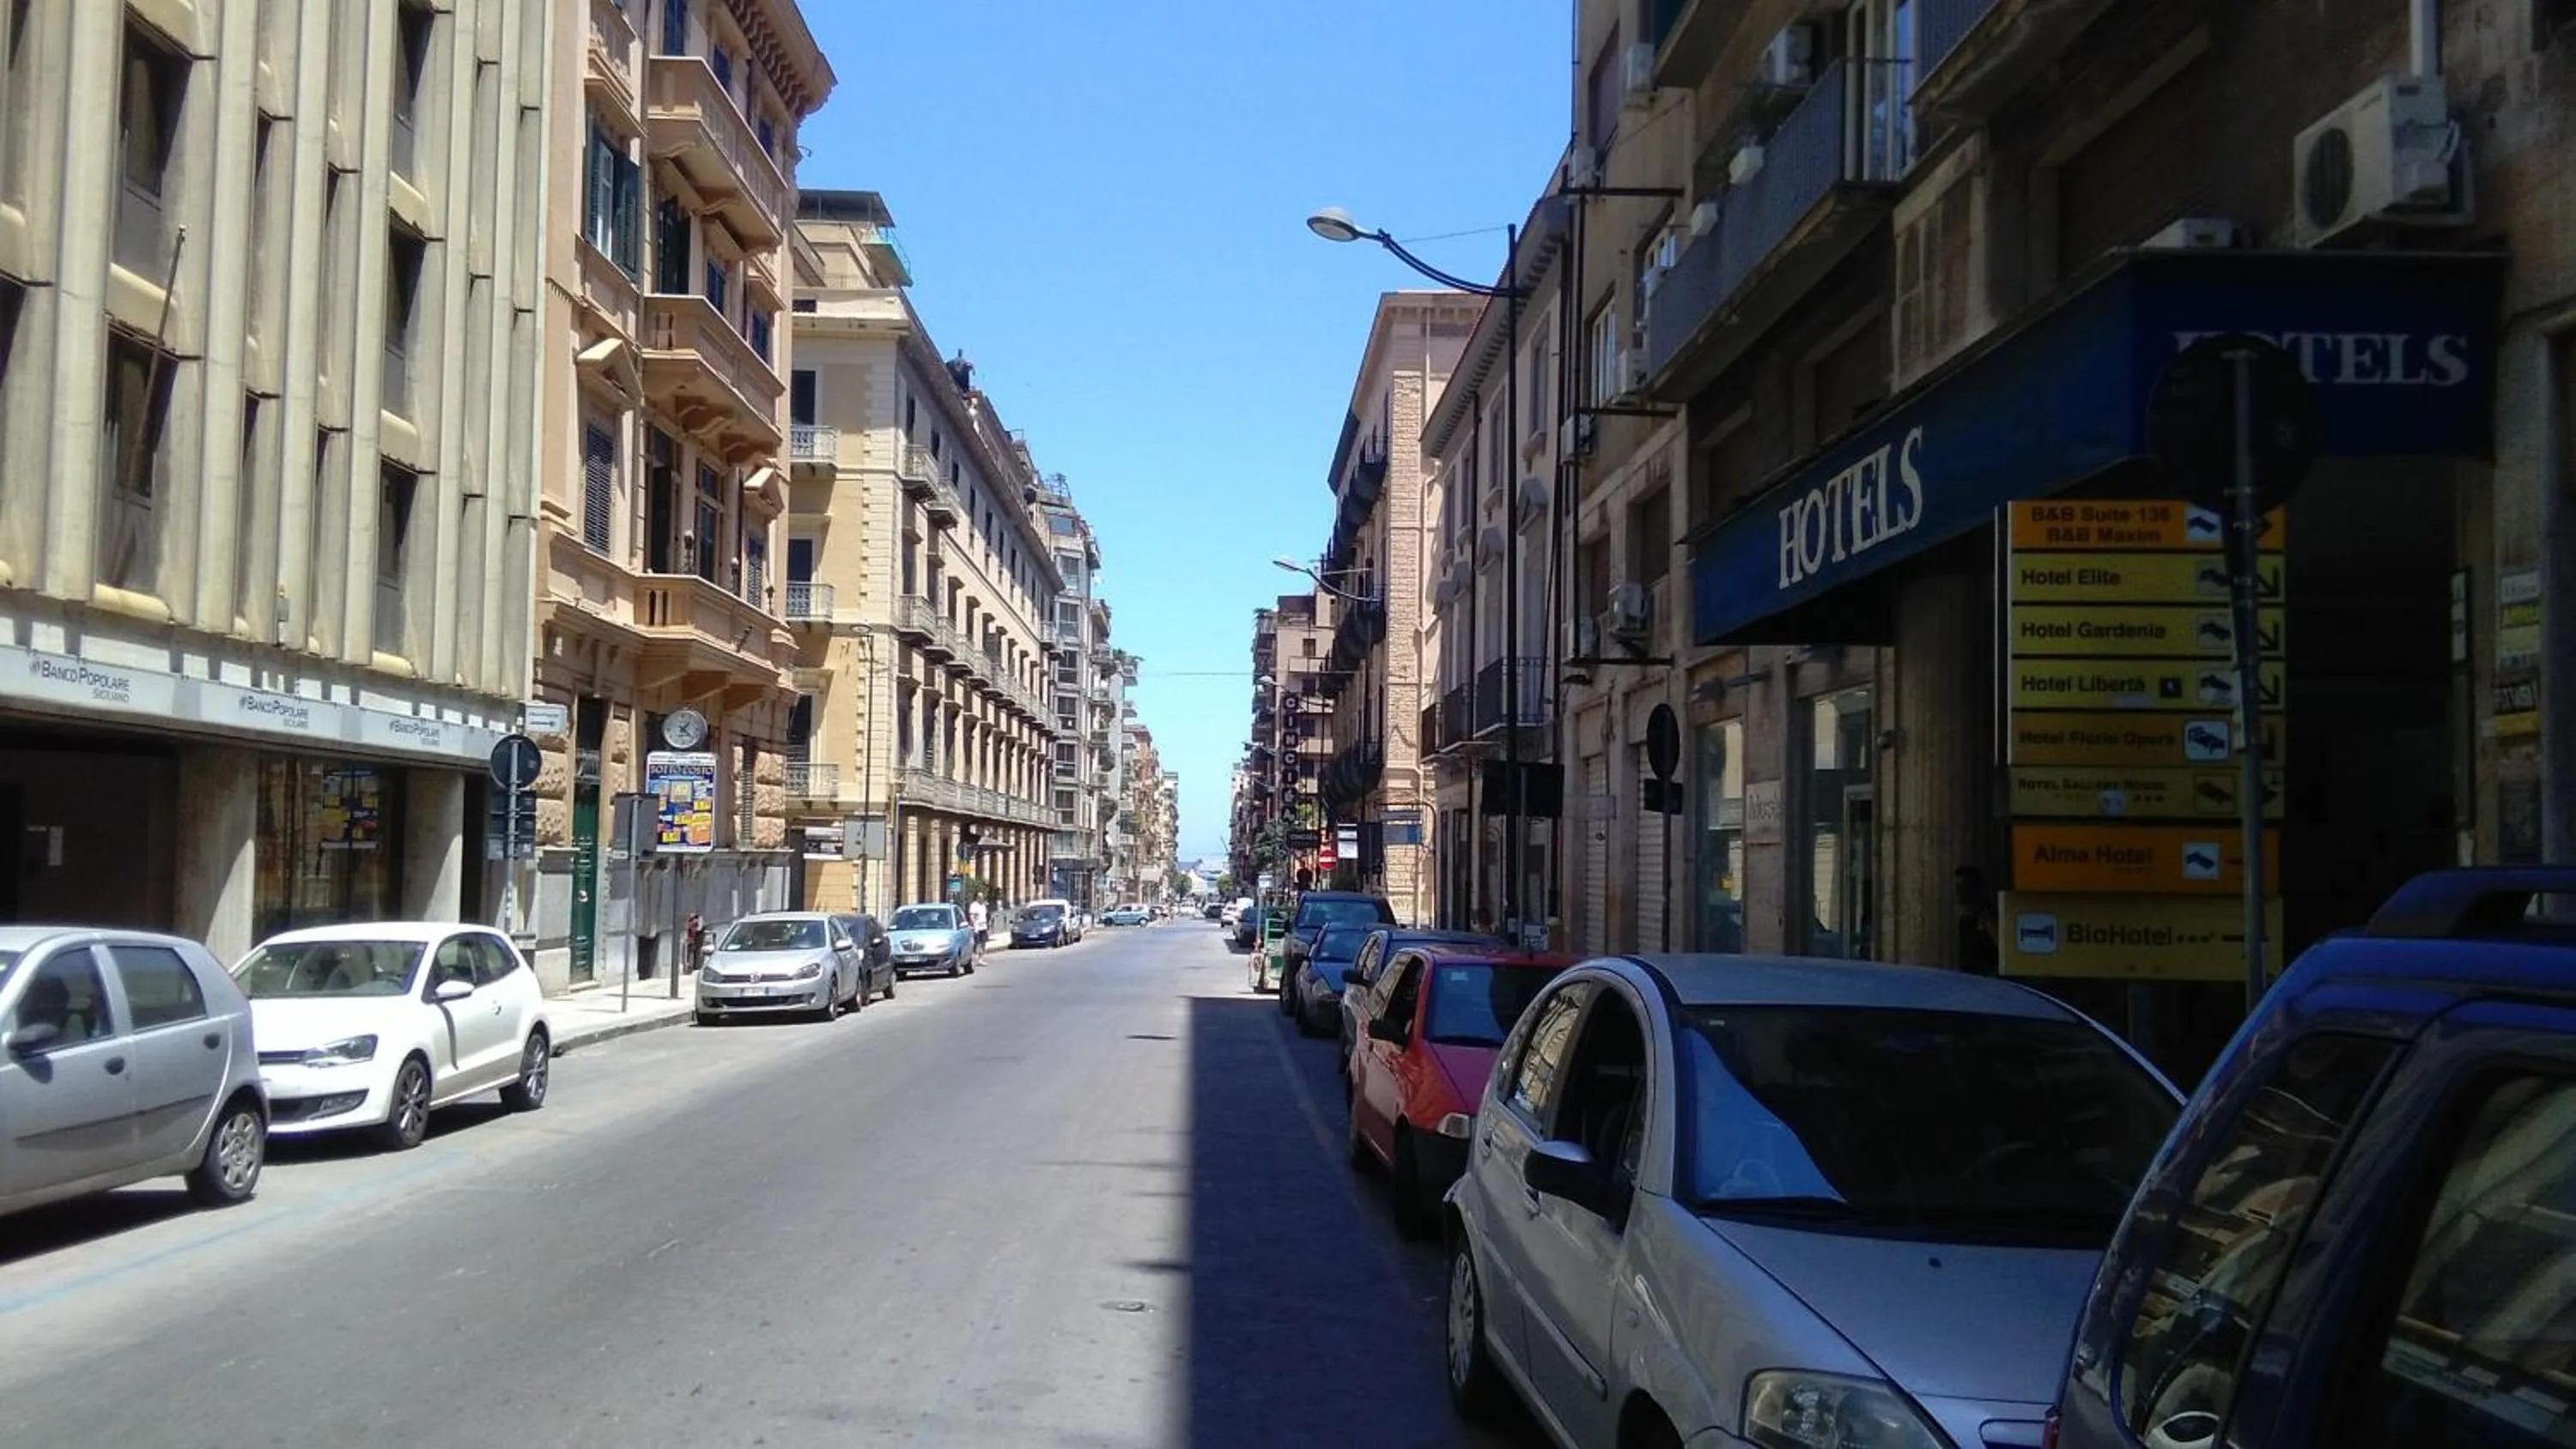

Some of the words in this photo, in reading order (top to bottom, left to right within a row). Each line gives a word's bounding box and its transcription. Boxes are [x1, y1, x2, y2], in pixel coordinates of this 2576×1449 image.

[2171, 330, 2470, 387] TELS
[1777, 425, 1923, 591] HOTELS
[2031, 506, 2075, 523] B&B
[2081, 506, 2129, 523] Suite
[2047, 527, 2090, 543] B&B
[2098, 527, 2160, 543] Maxim
[2021, 569, 2071, 585] Hotel
[2078, 569, 2120, 585] Elite
[2021, 622, 2071, 638] Hotel
[2078, 622, 2166, 638] Gardenia
[2021, 676, 2071, 691] Hotel
[2019, 732, 2064, 746] Hotel
[2034, 845, 2089, 864] Alma
[2095, 845, 2152, 864] Hotel
[2067, 923, 2172, 946] BioHotel
